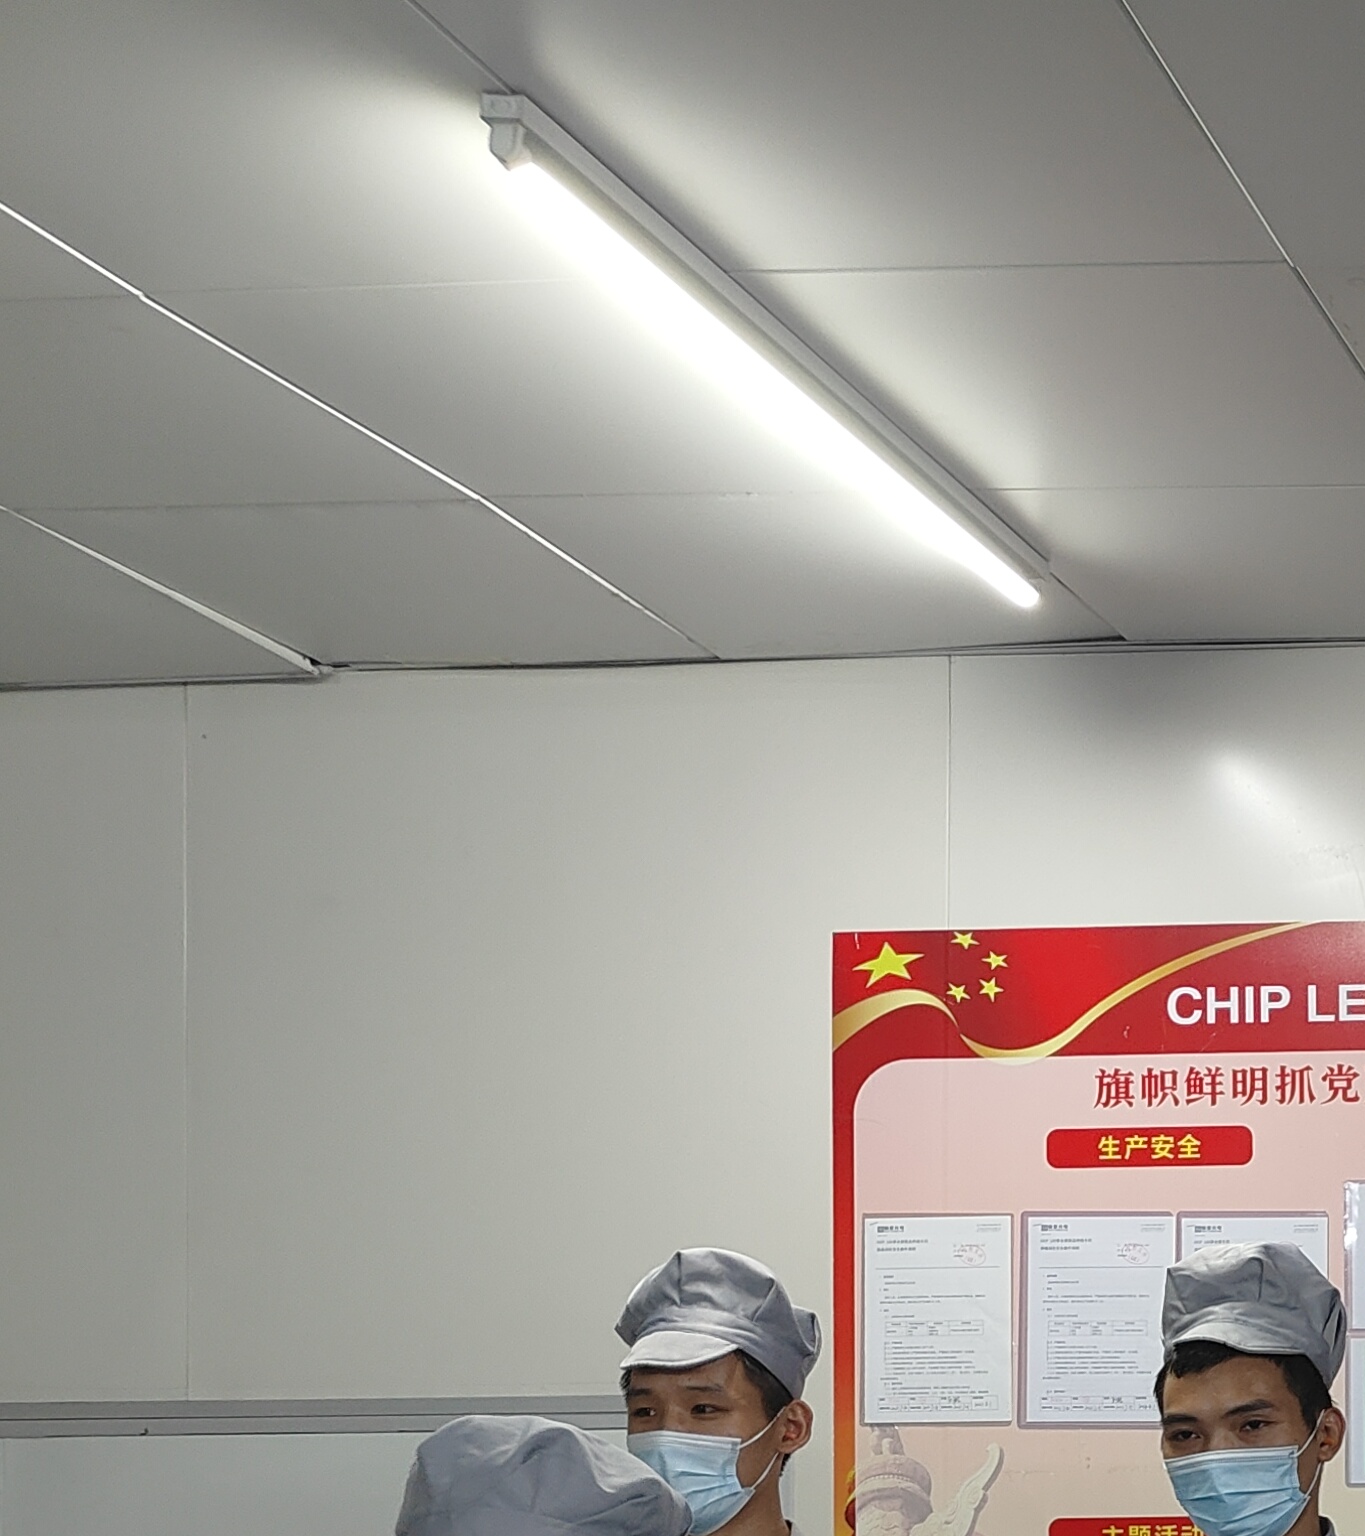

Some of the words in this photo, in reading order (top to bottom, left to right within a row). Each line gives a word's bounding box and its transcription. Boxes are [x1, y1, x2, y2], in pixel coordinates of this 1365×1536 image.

[1166, 985, 1291, 1026] CHIP
[1097, 1134, 1202, 1160] 生产安全
